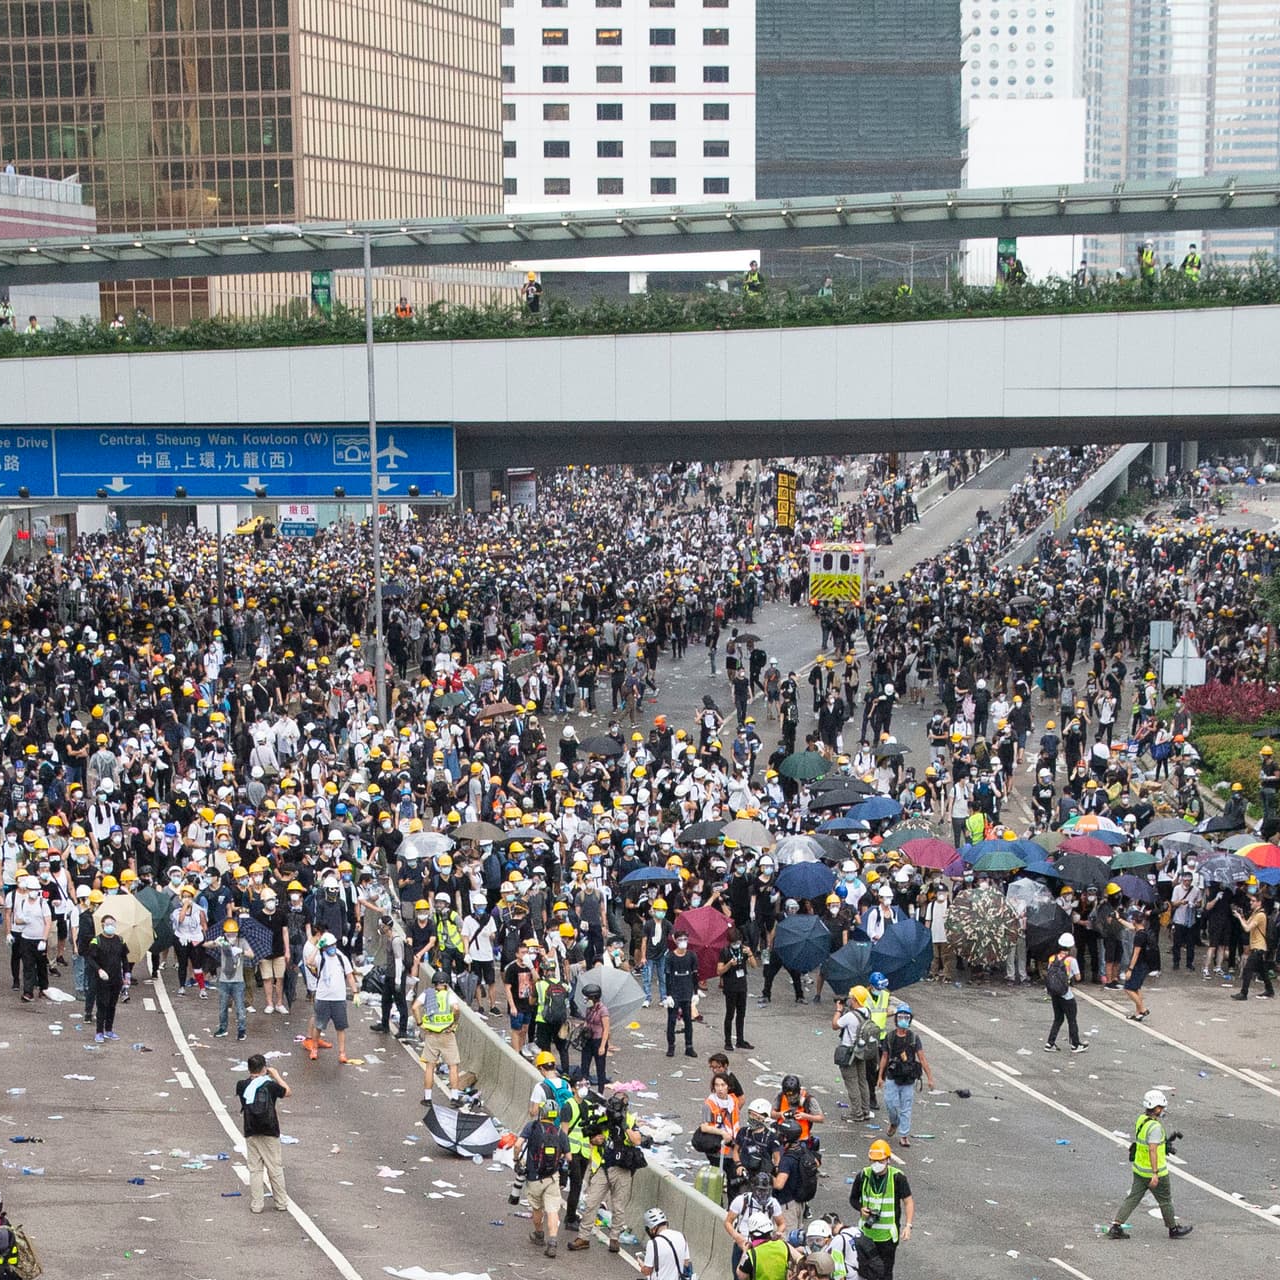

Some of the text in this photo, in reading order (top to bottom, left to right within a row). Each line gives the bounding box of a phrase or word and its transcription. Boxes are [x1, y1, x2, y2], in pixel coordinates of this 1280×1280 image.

[17, 438, 49, 448] Drive
[155, 434, 201, 446] Sheung
[243, 434, 298, 445] Kowloon
[304, 433, 329, 446] (W)
